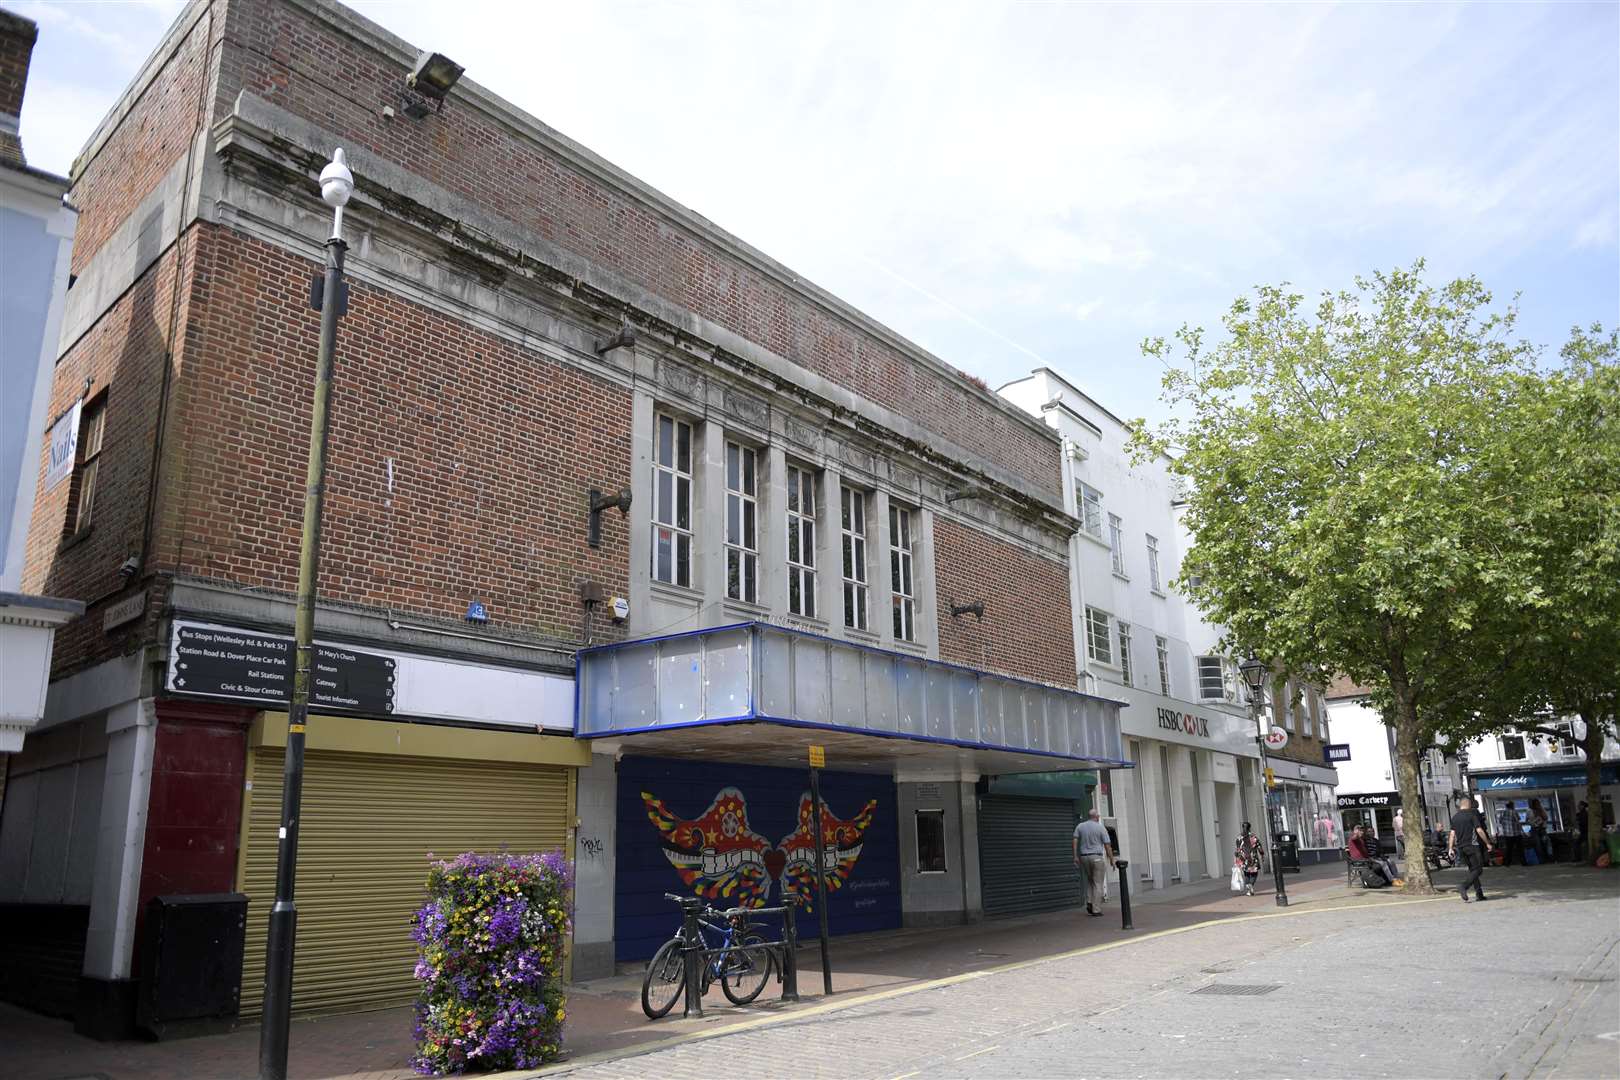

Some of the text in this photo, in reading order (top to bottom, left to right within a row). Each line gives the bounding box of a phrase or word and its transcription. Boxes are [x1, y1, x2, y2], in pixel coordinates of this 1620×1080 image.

[48, 429, 77, 474] Nails
[181, 630, 194, 639] Bus
[194, 632, 213, 643] Stops
[214, 634, 245, 647] (Wellesley
[246, 639, 256, 647] Rd.
[263, 641, 277, 650] Park
[276, 642, 288, 653] St.)
[179, 646, 287, 667] Station Road & Dover Place Car Park
[318, 649, 357, 663] St Mary's Church
[247, 670, 284, 681] Rail Stations
[317, 664, 338, 673] Museum
[220, 683, 285, 697] Civic & Stour Centres
[315, 692, 359, 705] Tourist Information
[1157, 707, 1210, 739] HSBC UK
[1329, 748, 1349, 759] MANN
